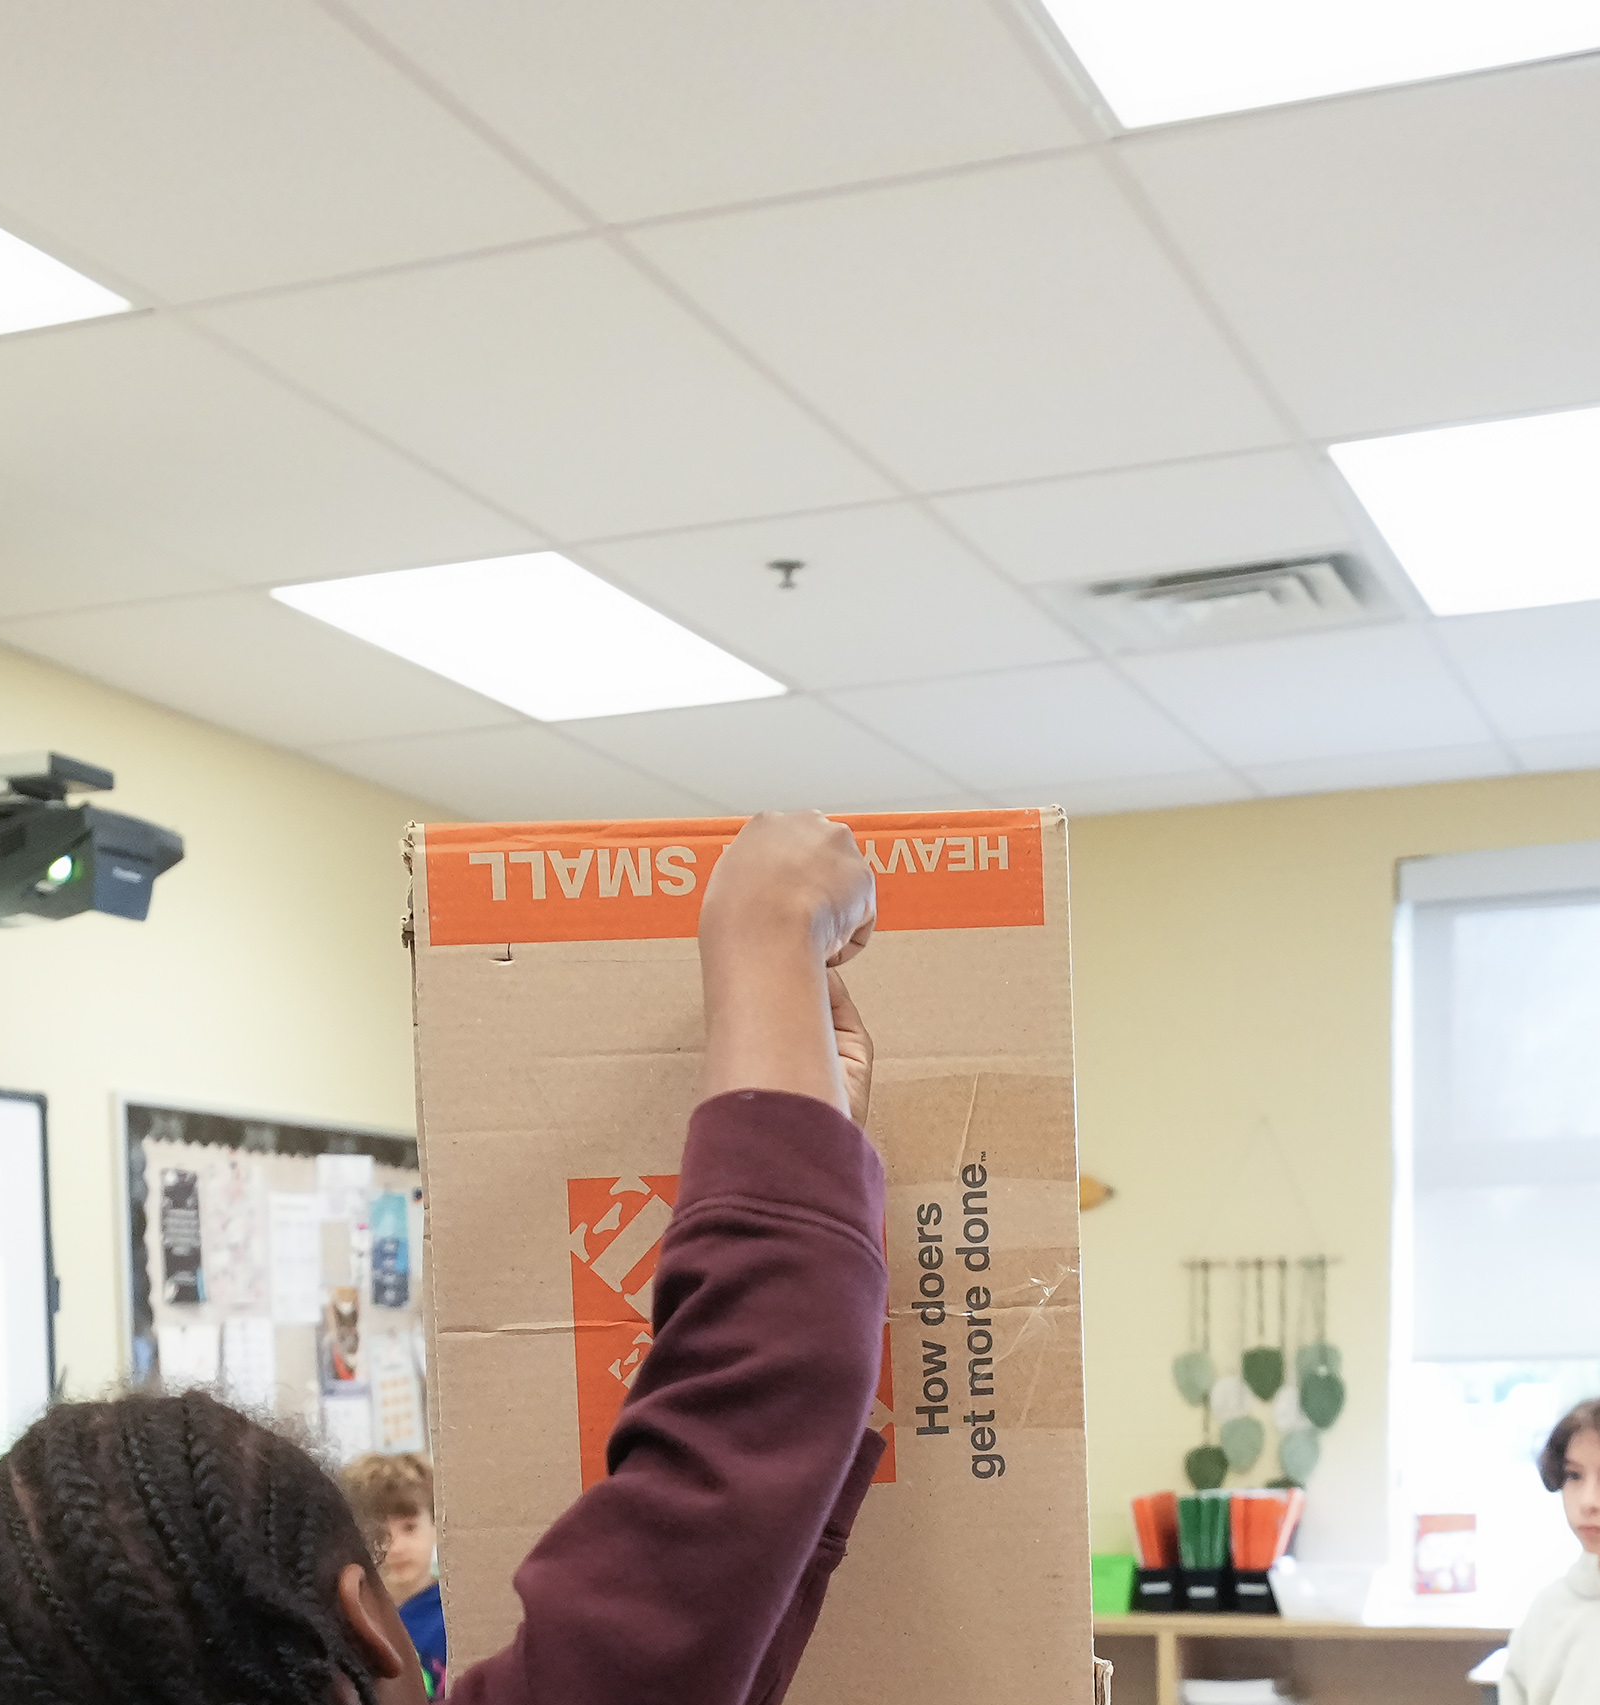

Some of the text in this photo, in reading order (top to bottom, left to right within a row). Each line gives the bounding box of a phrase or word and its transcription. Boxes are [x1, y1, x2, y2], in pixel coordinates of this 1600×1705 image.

[469, 844, 698, 902] SMALL
[862, 834, 1010, 875] HEAVY
[911, 1201, 950, 1436] How doers
[965, 1285, 995, 1397] more
[963, 1409, 1006, 1480] get
